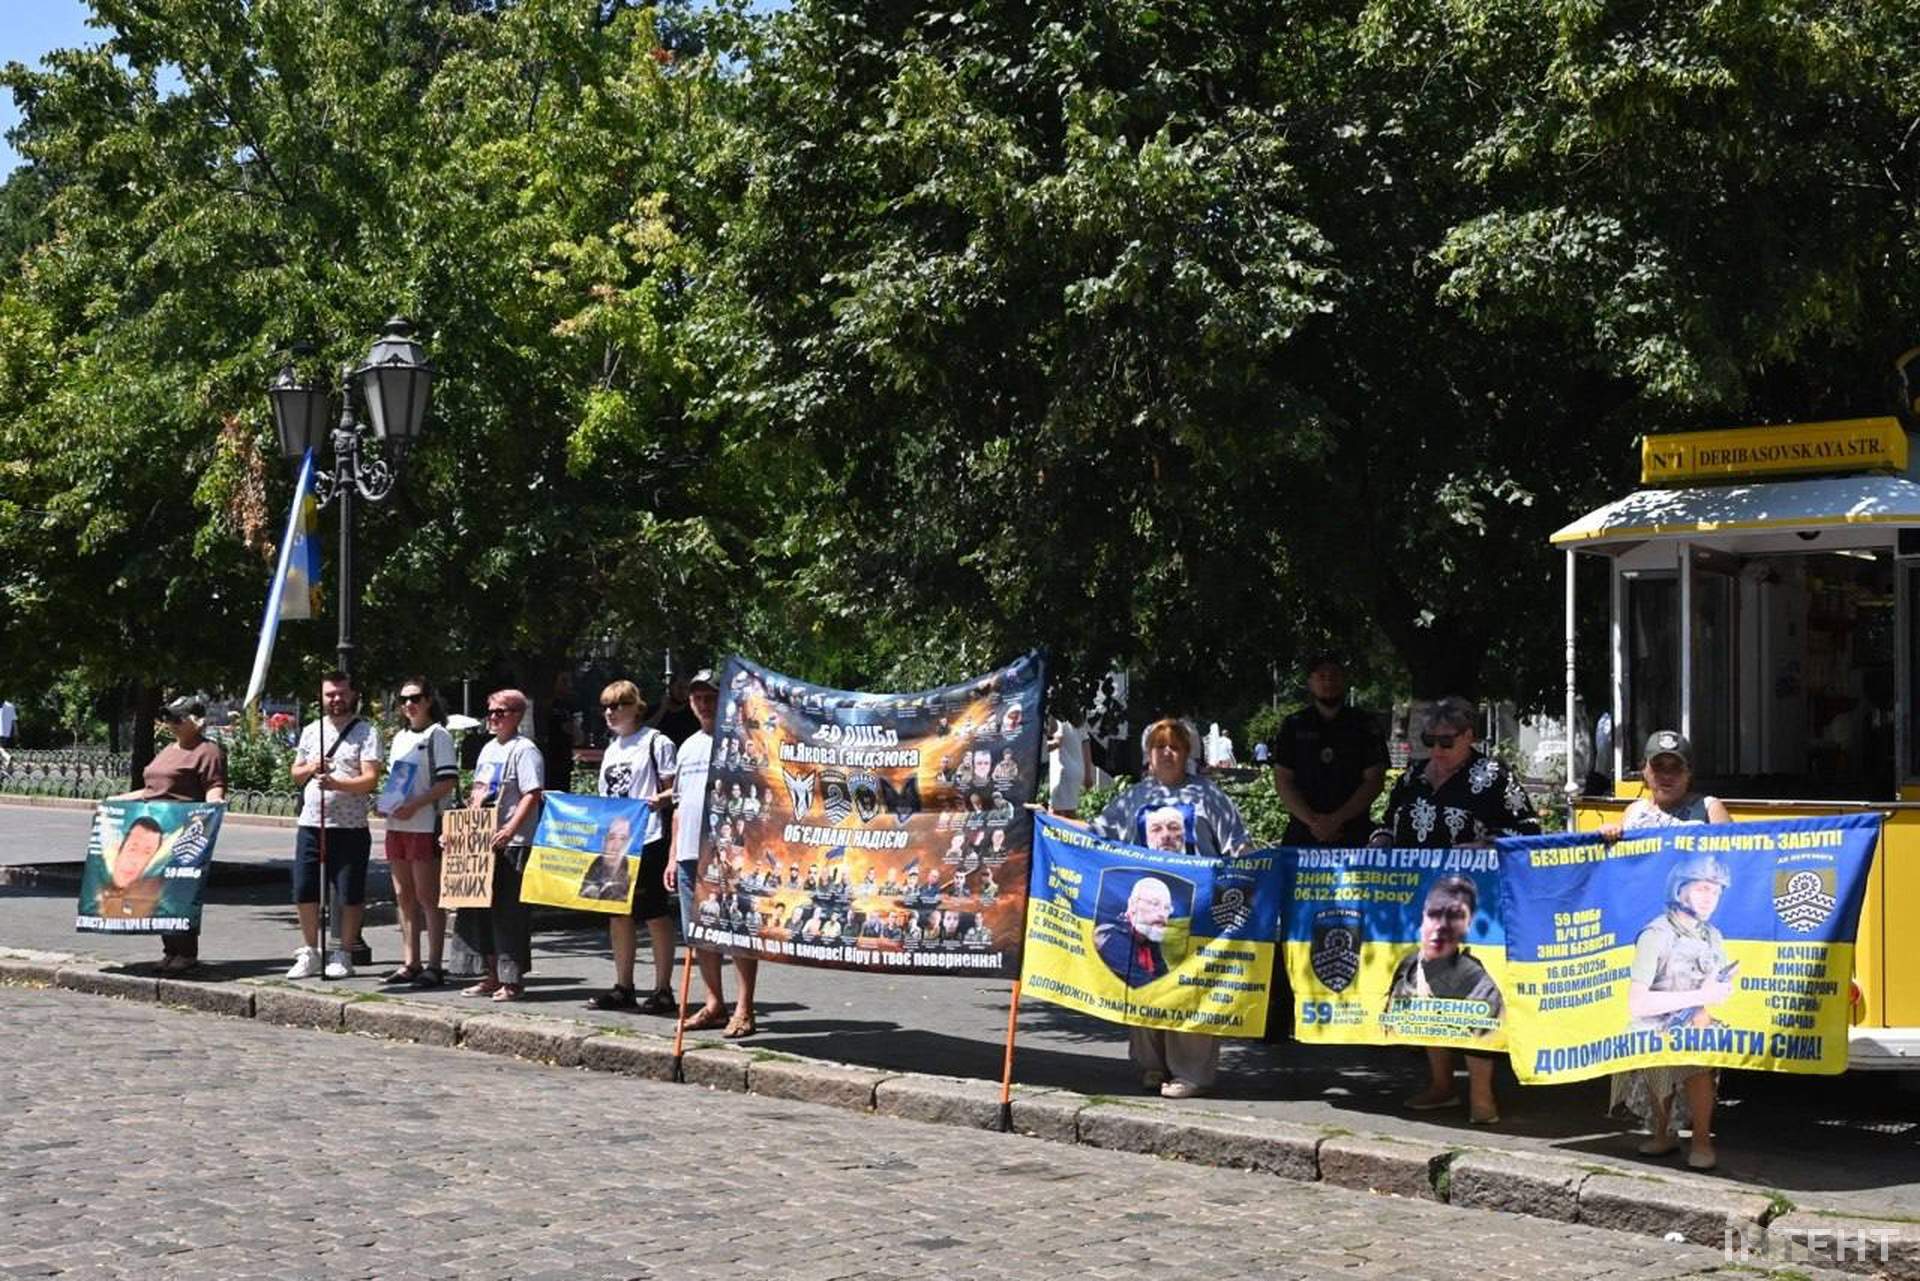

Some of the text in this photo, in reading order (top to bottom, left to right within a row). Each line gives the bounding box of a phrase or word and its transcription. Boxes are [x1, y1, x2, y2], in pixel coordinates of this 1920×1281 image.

[1700, 442, 1844, 465] DERIBASOVSKAYA
[1848, 437, 1885, 454] STR.
[839, 748, 919, 769] Гандзюка
[448, 810, 491, 833] ПОЧУЙ
[852, 831, 909, 849] НАДІЄЮ
[1529, 844, 1607, 867] БЕЗВІСТИ
[1674, 835, 1695, 851] НЕ
[1697, 834, 1775, 852] ЗНАЧИТЬ
[1297, 848, 1388, 869] ПОВЕРНІТЬ
[1390, 848, 1442, 869] ГЕРОЯ
[1295, 871, 1420, 886] ЗНИК БЕЗВІСТИ
[1294, 887, 1415, 904] 06.12.2024 року
[1553, 912, 1571, 927] 59
[782, 942, 795, 955] не
[871, 953, 880, 964] в
[881, 952, 912, 966] твоє
[913, 952, 1003, 969] повернення!
[1536, 944, 1569, 959] ЗНИК
[1028, 974, 1096, 1005] ДОПОМОЖІТЬ
[1098, 997, 1137, 1014] ЗНАЙТИ
[1138, 1006, 1168, 1019] СИНА
[1171, 1009, 1184, 1021] ТА
[1391, 999, 1489, 1016] ДМИТРЕНКО
[1538, 991, 1594, 1012] ДОНЕЦЬКА
[1302, 1001, 1333, 1025] 59
[1533, 1023, 1824, 1075] ДОПОМОЖІТЬ ЗНАЙТИ СИНА!
